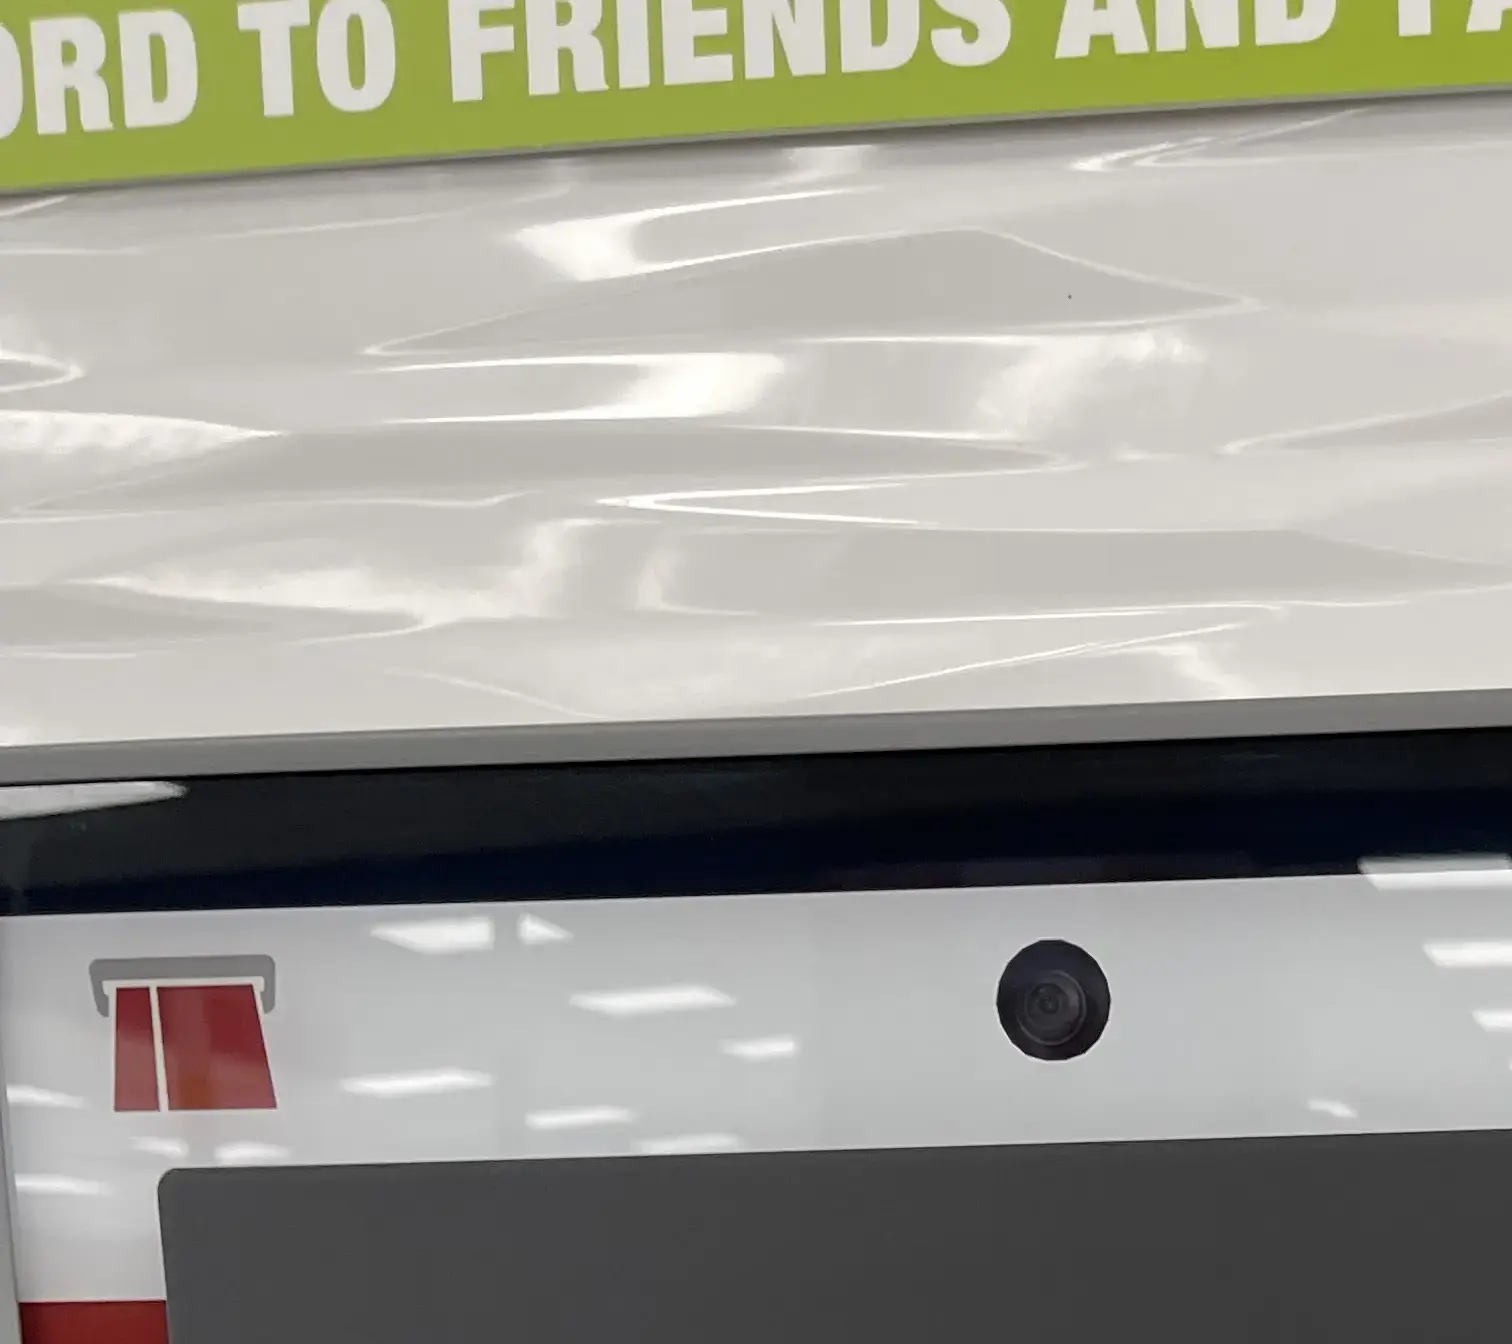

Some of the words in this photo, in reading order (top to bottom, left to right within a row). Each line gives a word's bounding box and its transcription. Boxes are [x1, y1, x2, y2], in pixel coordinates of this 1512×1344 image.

[0, 9, 198, 141] RD
[237, 0, 397, 117] TO
[449, 0, 1011, 102] FRIENDS
